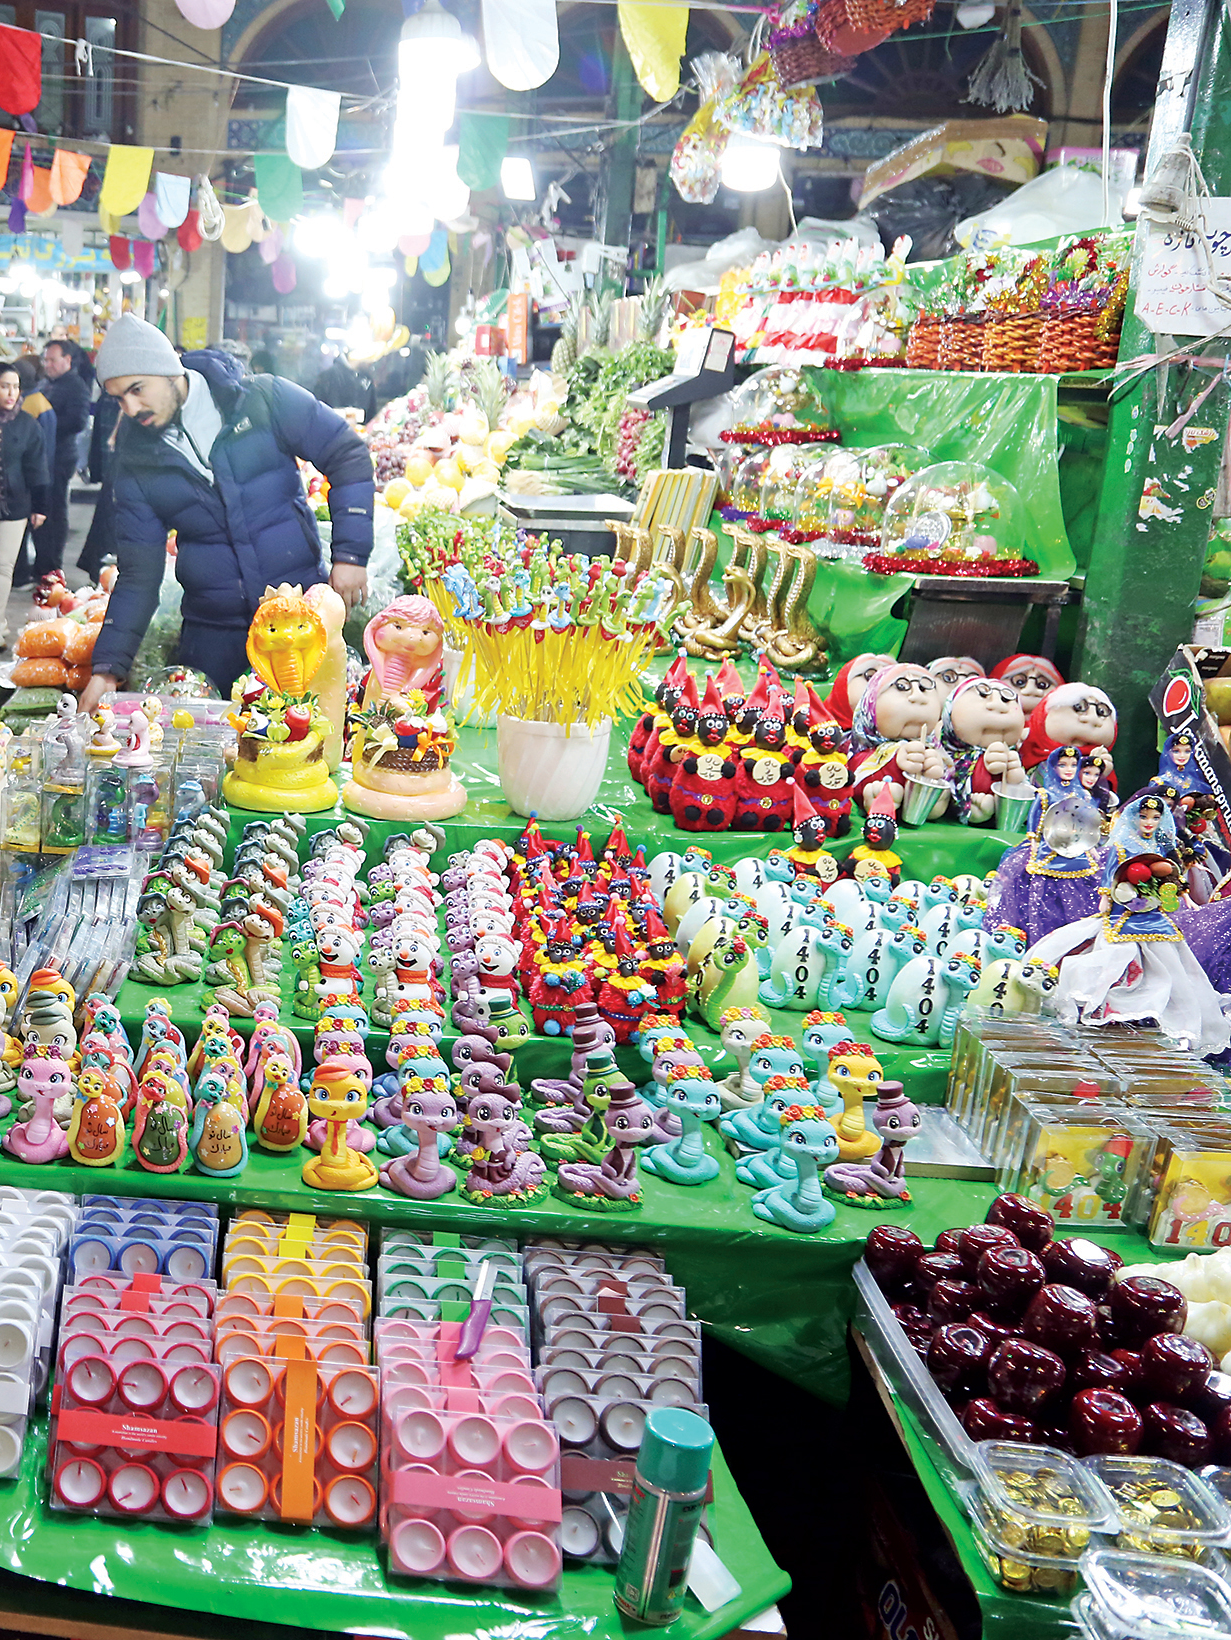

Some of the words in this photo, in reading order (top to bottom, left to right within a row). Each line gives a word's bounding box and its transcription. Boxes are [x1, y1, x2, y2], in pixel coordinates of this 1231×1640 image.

[793, 928, 810, 1000] 1404
[865, 931, 884, 1001] 1404
[915, 959, 935, 1034] 1404
